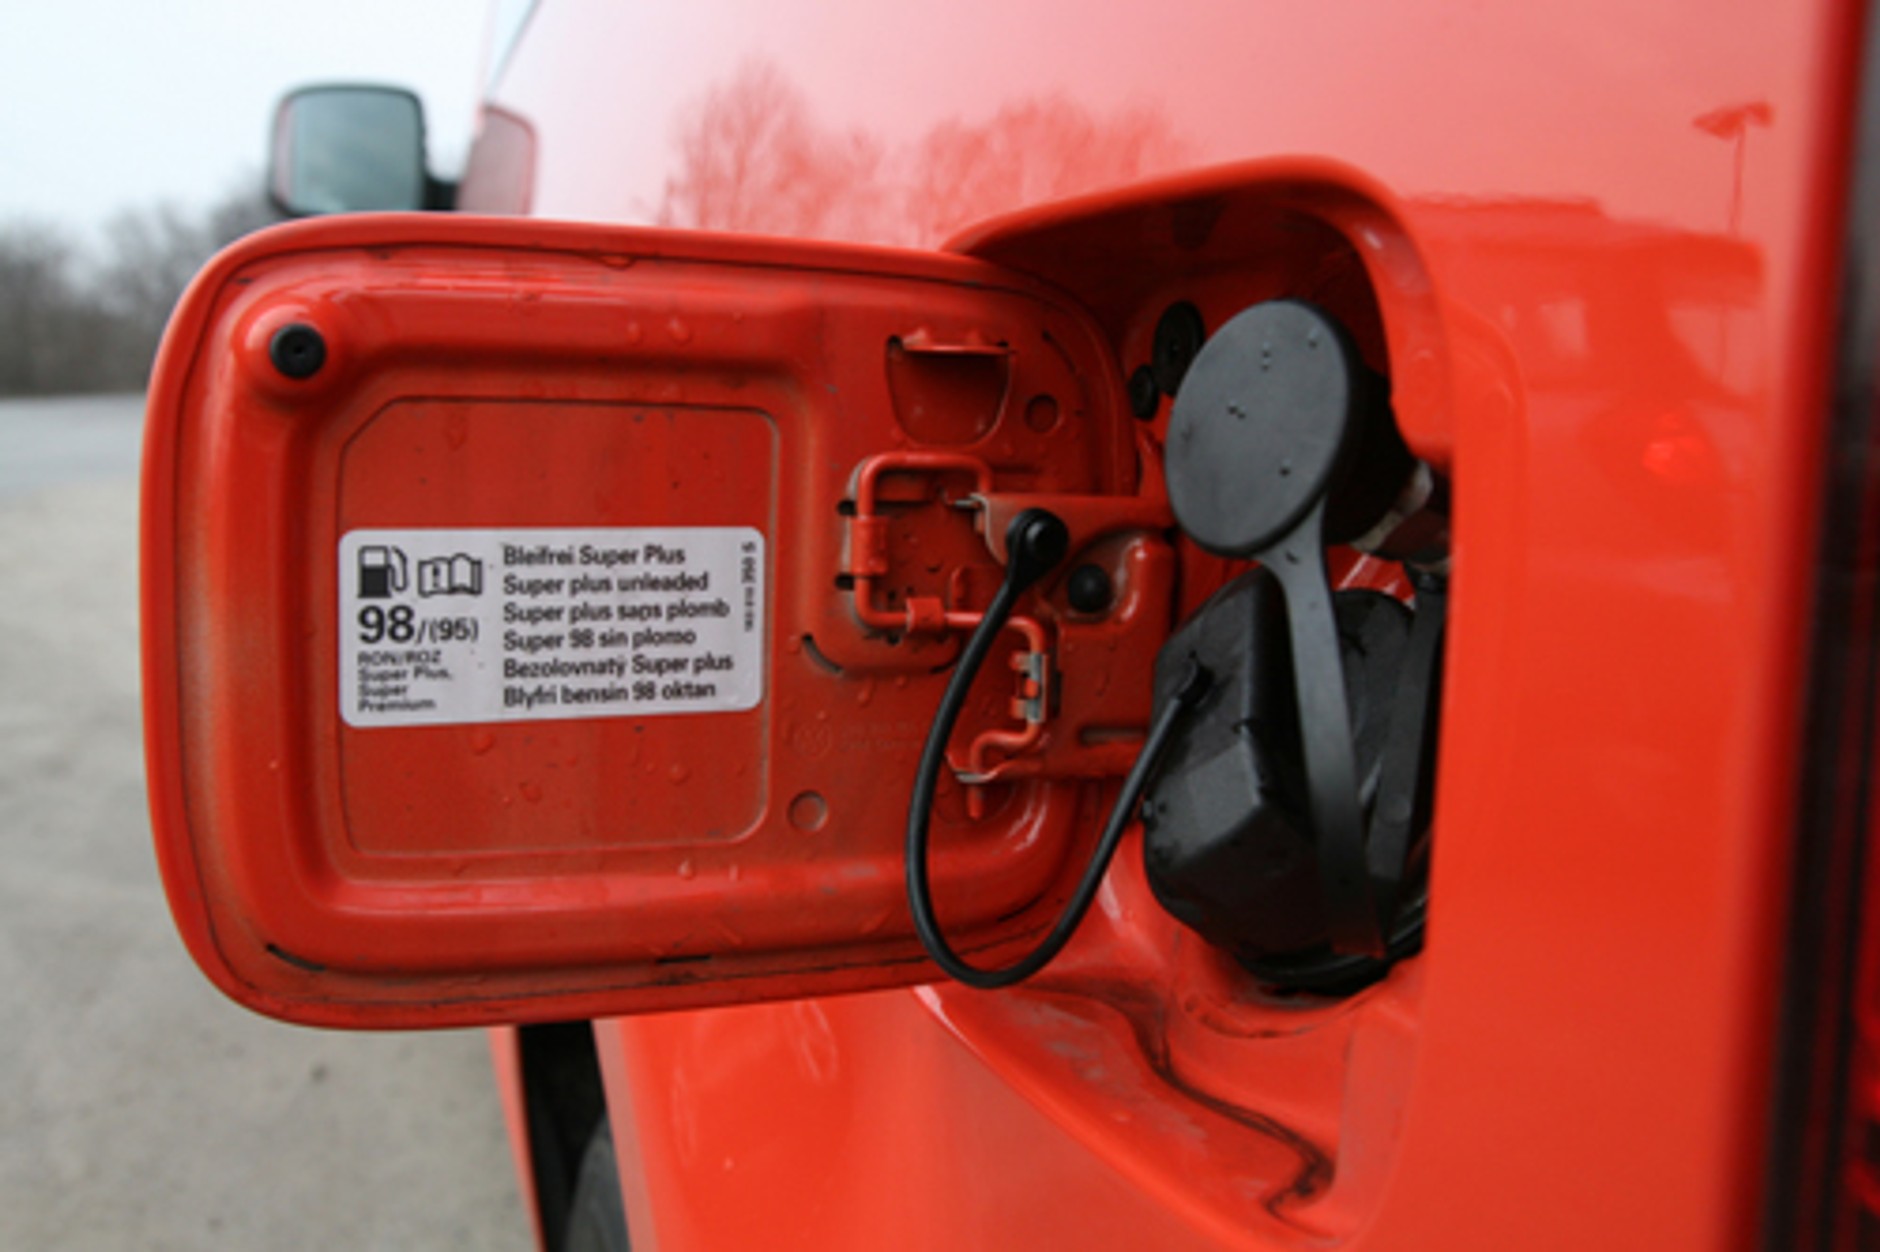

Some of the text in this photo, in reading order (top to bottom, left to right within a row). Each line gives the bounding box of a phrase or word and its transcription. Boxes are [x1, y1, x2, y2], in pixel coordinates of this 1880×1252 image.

[503, 545, 686, 567] Bleifrei Super Plus
[503, 571, 709, 597] Super plus unleaded
[503, 602, 565, 624] Super
[569, 601, 612, 623] plus
[666, 598, 730, 621] plomb
[503, 628, 697, 653] Super 98 sin plomo
[358, 668, 408, 683] Super
[631, 653, 689, 676] Super
[693, 652, 734, 674] plus
[358, 683, 408, 698] Super
[503, 680, 716, 708] Blyfri bensin 98 oktan
[357, 698, 437, 712] Premium
